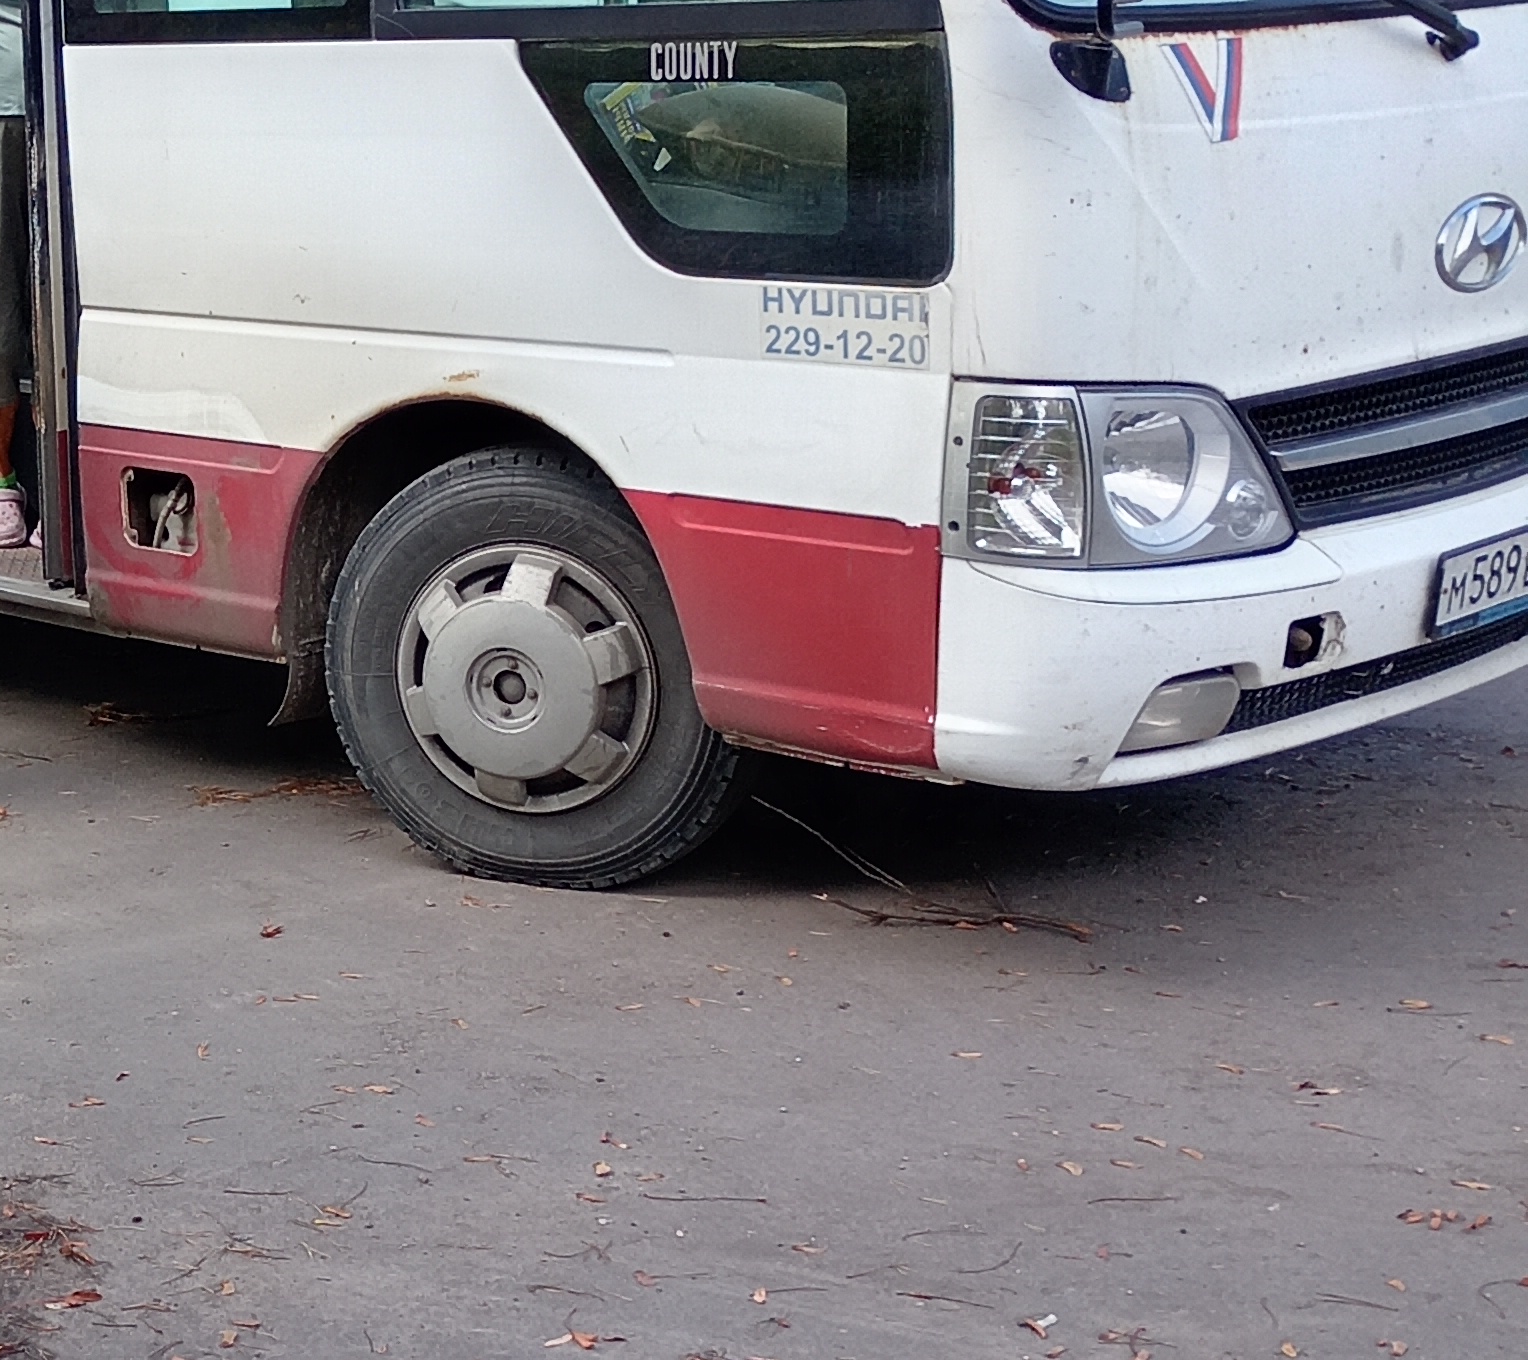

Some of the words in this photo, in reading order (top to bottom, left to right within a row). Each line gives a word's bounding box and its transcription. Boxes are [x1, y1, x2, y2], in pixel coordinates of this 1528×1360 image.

[650, 41, 737, 81] COUNTY
[762, 286, 930, 322] HYUNDAI
[765, 324, 927, 365] 229-12-20
[1446, 544, 1528, 615] М589
